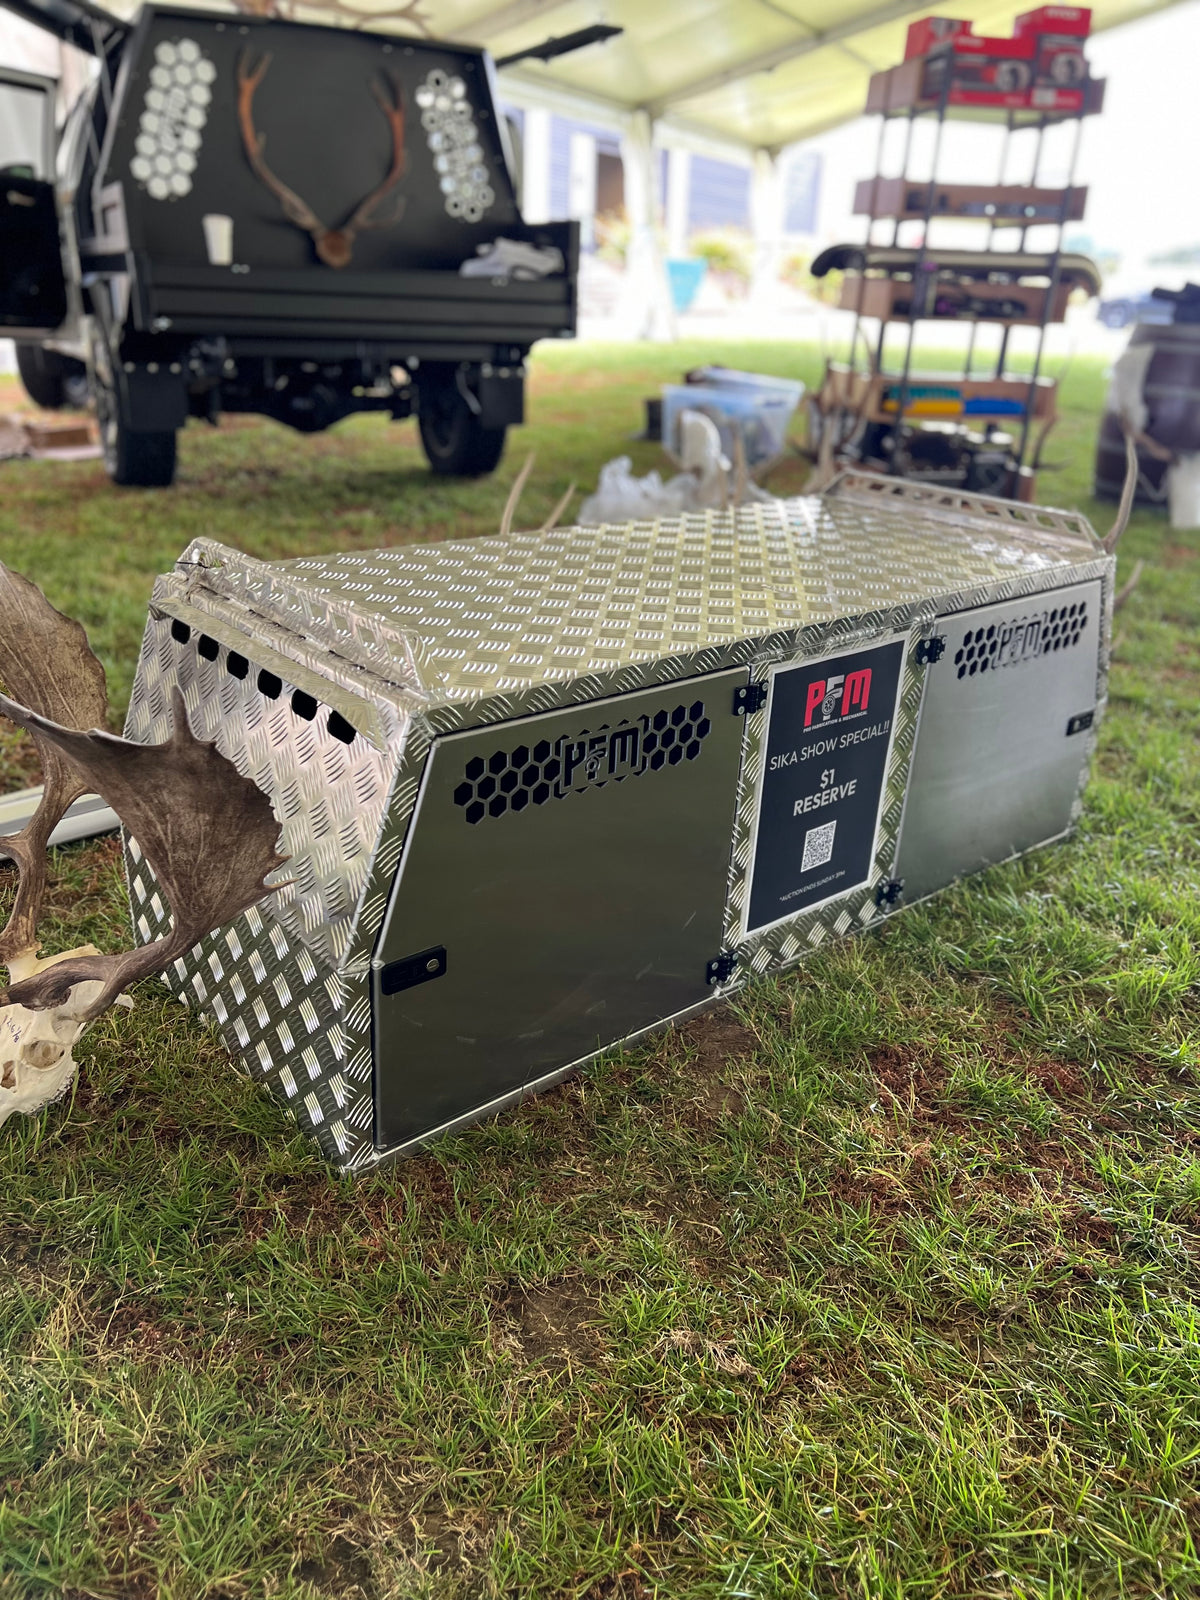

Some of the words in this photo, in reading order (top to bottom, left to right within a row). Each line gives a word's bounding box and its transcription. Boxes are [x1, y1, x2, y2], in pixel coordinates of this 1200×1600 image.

[998, 620, 1041, 660] PFM
[804, 668, 872, 727] PFM
[812, 719, 837, 730] FABRICATION
[843, 710, 867, 721] MECHANICAL
[564, 727, 640, 787] PFM
[769, 751, 798, 771] SIKA
[800, 737, 838, 761] SHOW
[838, 720, 890, 749] SPECIAL!!
[793, 779, 857, 816] RESERVE
[820, 768, 835, 789] $1
[803, 881, 816, 892] ENDS
[816, 875, 835, 887] SUNDAY
